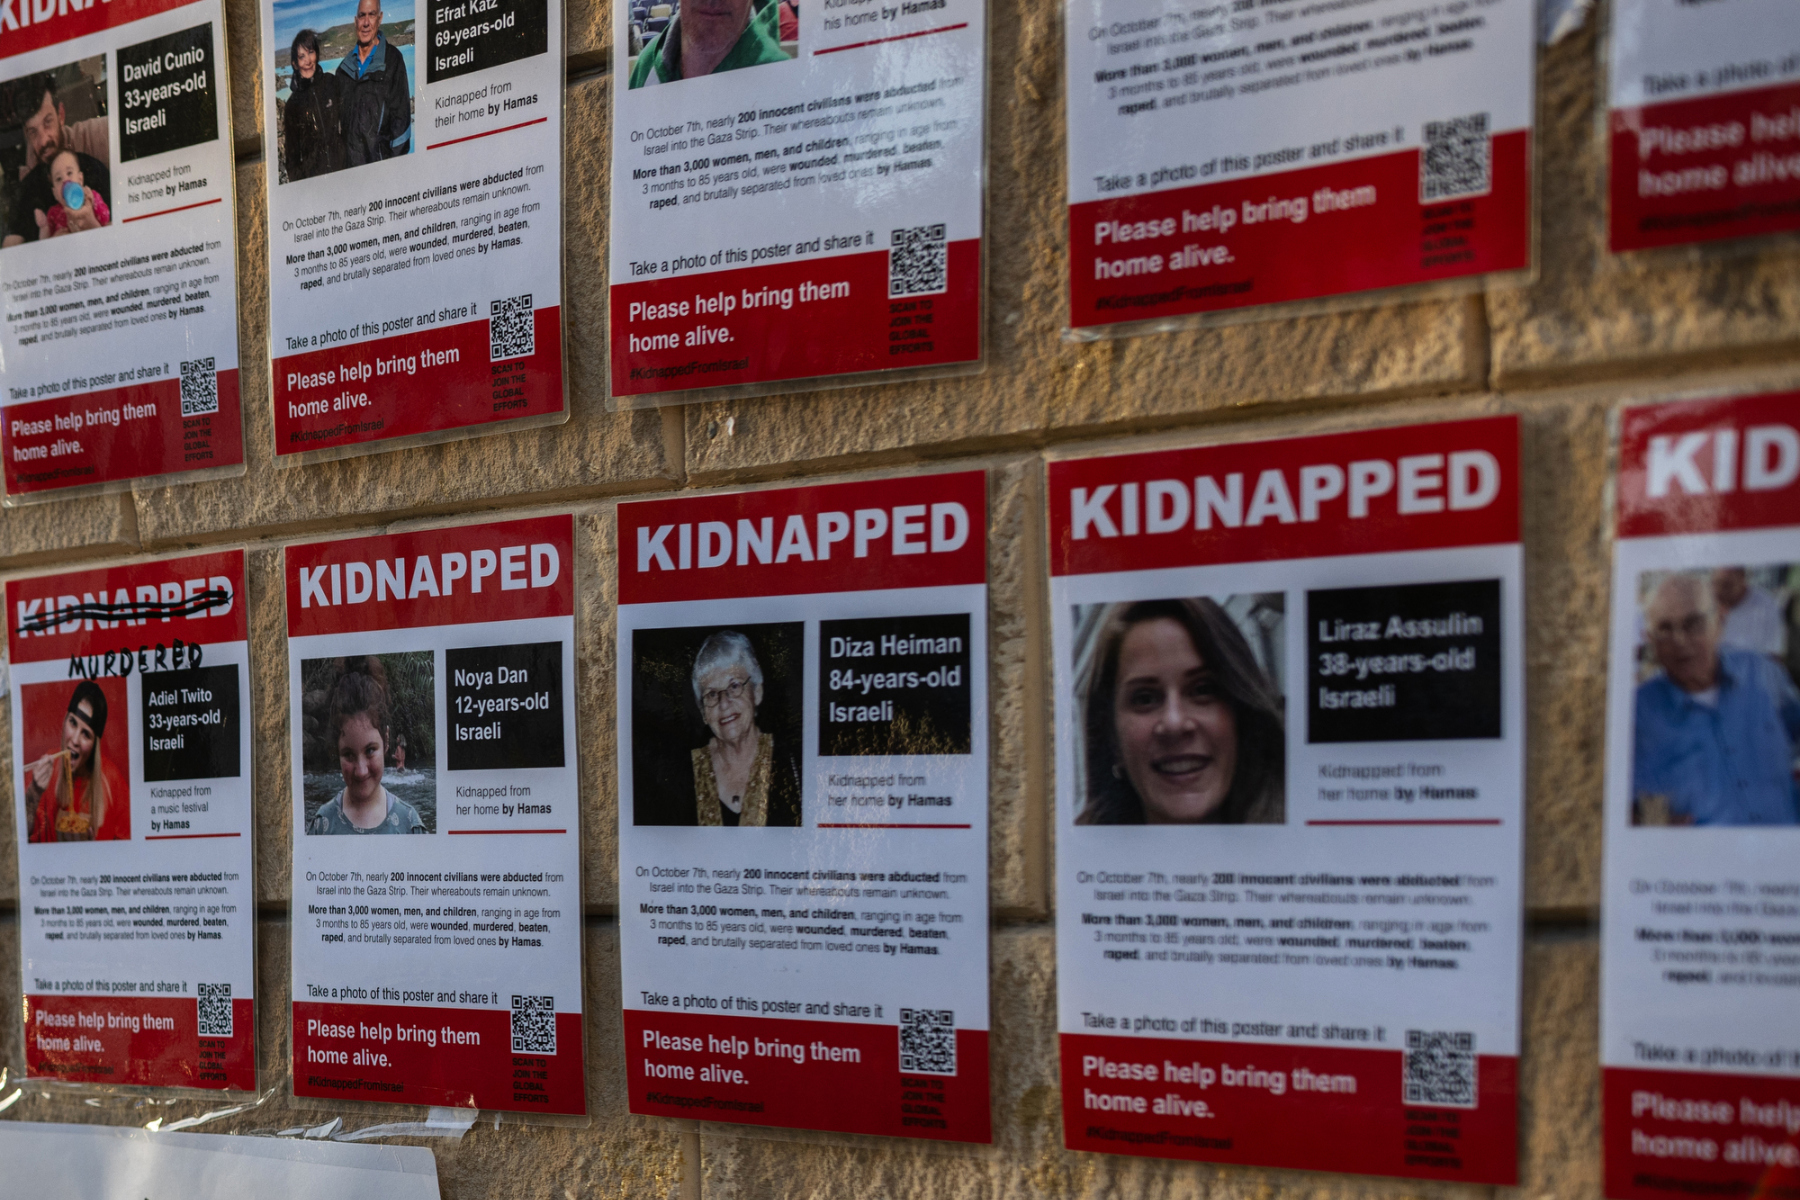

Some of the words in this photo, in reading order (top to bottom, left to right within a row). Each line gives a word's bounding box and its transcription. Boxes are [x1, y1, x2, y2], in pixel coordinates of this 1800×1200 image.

[436, 3, 466, 25] Efrat
[469, 0, 498, 15] Katz
[824, 18, 841, 30] his
[844, 11, 878, 26] home
[881, 6, 898, 22] by
[901, 0, 950, 16] Hamas
[435, 11, 515, 47] 69-years-old
[124, 56, 162, 83] David
[164, 47, 205, 71] Cunio
[435, 47, 474, 71] Israeli
[124, 70, 207, 108] 33-years-old
[435, 85, 488, 110] Kidnapped
[490, 81, 512, 96] from
[125, 108, 166, 135] Israeli
[435, 113, 456, 129] their
[458, 107, 485, 123] home
[487, 103, 501, 117] by
[503, 93, 539, 112] Hamas
[127, 167, 172, 187] Kidnapped
[172, 164, 191, 184] from
[128, 193, 140, 203] his
[141, 188, 164, 200] home
[165, 184, 177, 197] by
[178, 177, 208, 193] Hamas
[629, 300, 690, 323] Please
[695, 291, 737, 316] help
[742, 286, 793, 310] bring
[798, 280, 850, 303] them
[629, 333, 680, 353] home
[684, 324, 734, 347] alive.
[287, 370, 336, 392] Please
[340, 361, 372, 383] help
[376, 354, 416, 376] bring
[420, 347, 460, 368] them
[288, 399, 329, 419] home
[333, 391, 372, 411] alive.
[11, 419, 53, 437] Please
[54, 411, 83, 432] help
[85, 407, 120, 427] bring
[122, 402, 157, 421] them
[12, 445, 48, 462] home
[50, 438, 84, 457] alive.
[1071, 450, 1499, 540] KIDNAPPED
[637, 501, 970, 573] KIDNAPPED
[299, 542, 560, 609] KIDNAPPED
[1319, 620, 1381, 642] Liraz
[1384, 613, 1483, 638] Assulin
[830, 636, 874, 658] Diza
[881, 633, 962, 656] Heiman
[68, 638, 203, 681] MURDERED
[1319, 647, 1475, 680] 38-years-old
[454, 668, 493, 690] Noya
[498, 666, 528, 684] Dan
[829, 665, 961, 695] 84-years-old
[148, 689, 178, 707] Adiel
[180, 687, 213, 704] Twito
[455, 691, 549, 718] 12-years-old
[1319, 685, 1395, 709] Israeli
[149, 709, 221, 732] 33-years-old
[829, 700, 893, 723] Israeli
[149, 733, 184, 751] Israeli
[455, 721, 501, 741] Israeli
[150, 786, 193, 799] Kidnapped
[193, 785, 212, 797] from
[456, 785, 507, 800] Kidnapped
[509, 784, 531, 797] from
[150, 805, 157, 815] a
[157, 804, 180, 814] music
[181, 801, 209, 813] festival
[456, 804, 471, 816] her
[473, 804, 500, 815] home
[502, 803, 515, 817] by
[517, 802, 552, 815] Hamas
[151, 820, 161, 833] by
[163, 819, 190, 830] Hamas
[305, 871, 317, 882] On
[318, 871, 348, 882] October
[350, 871, 364, 882] 7th,
[365, 872, 389, 884] nearly
[390, 871, 405, 882] 200
[406, 871, 442, 882] innocent
[443, 871, 479, 882] civilians
[480, 874, 501, 882] were
[502, 872, 543, 883] abducted
[545, 872, 564, 883] from
[316, 885, 337, 896] Israel
[337, 886, 352, 896] into
[353, 885, 366, 896] the
[366, 884, 387, 896] Gaza
[388, 885, 408, 898] Strip.
[410, 885, 430, 896] Their
[430, 886, 481, 897] whereabouts
[482, 886, 510, 897] remain
[511, 886, 551, 897] unknown.
[307, 1018, 356, 1039] Please
[360, 1021, 393, 1045] help
[396, 1023, 437, 1048] bring
[440, 1026, 480, 1046] them
[307, 1045, 348, 1065] home
[352, 1048, 392, 1067] alive.
[642, 1029, 703, 1060] Please
[708, 1034, 749, 1060] help
[754, 1037, 805, 1065] bring
[809, 1041, 861, 1063] them
[644, 1058, 695, 1081] home
[700, 1063, 749, 1085] alive.
[1082, 1055, 1159, 1082] Please
[1164, 1060, 1216, 1090] help
[1221, 1063, 1286, 1095] bring
[1291, 1068, 1357, 1093] them
[1084, 1087, 1148, 1114] home
[1152, 1093, 1215, 1118] alive.
